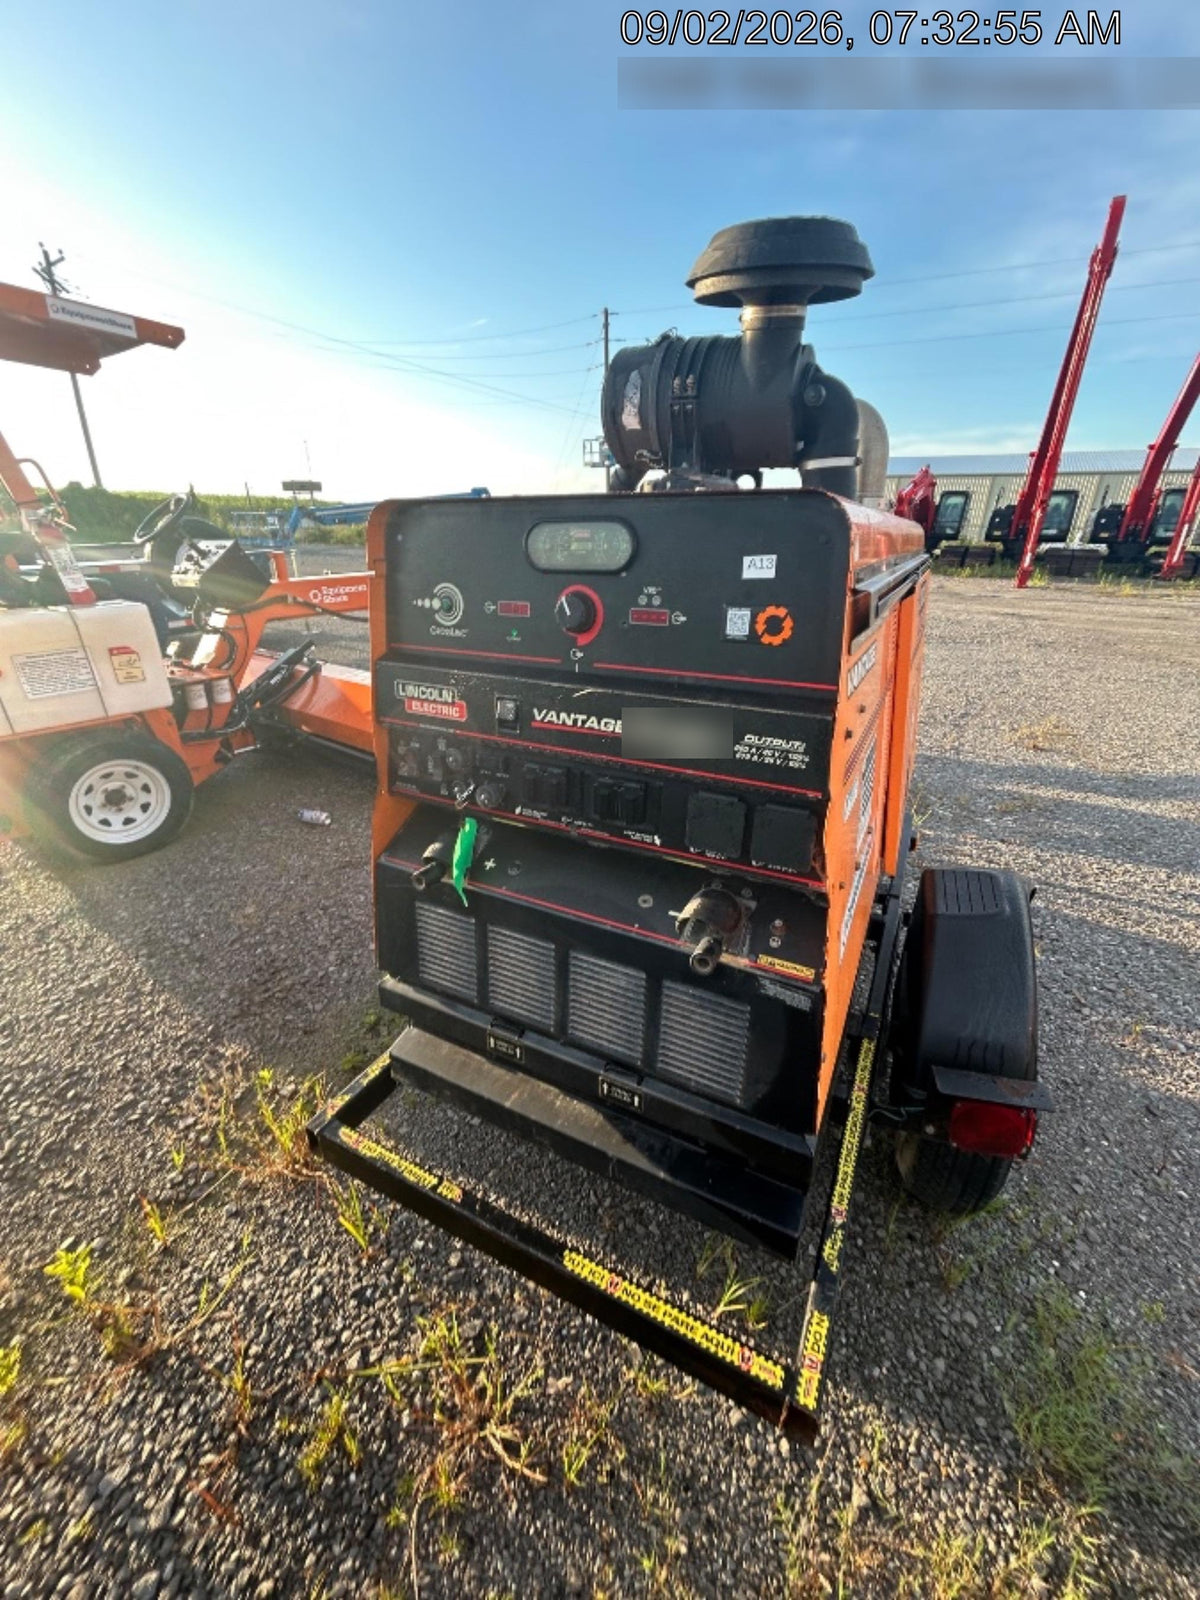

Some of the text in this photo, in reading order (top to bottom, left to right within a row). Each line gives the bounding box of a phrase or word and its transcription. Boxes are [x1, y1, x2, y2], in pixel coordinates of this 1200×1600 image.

[747, 557, 774, 570] A13
[398, 683, 453, 703] LINCOLN
[411, 700, 460, 717] ELECTRIC
[622, 1286, 641, 1303] NO
